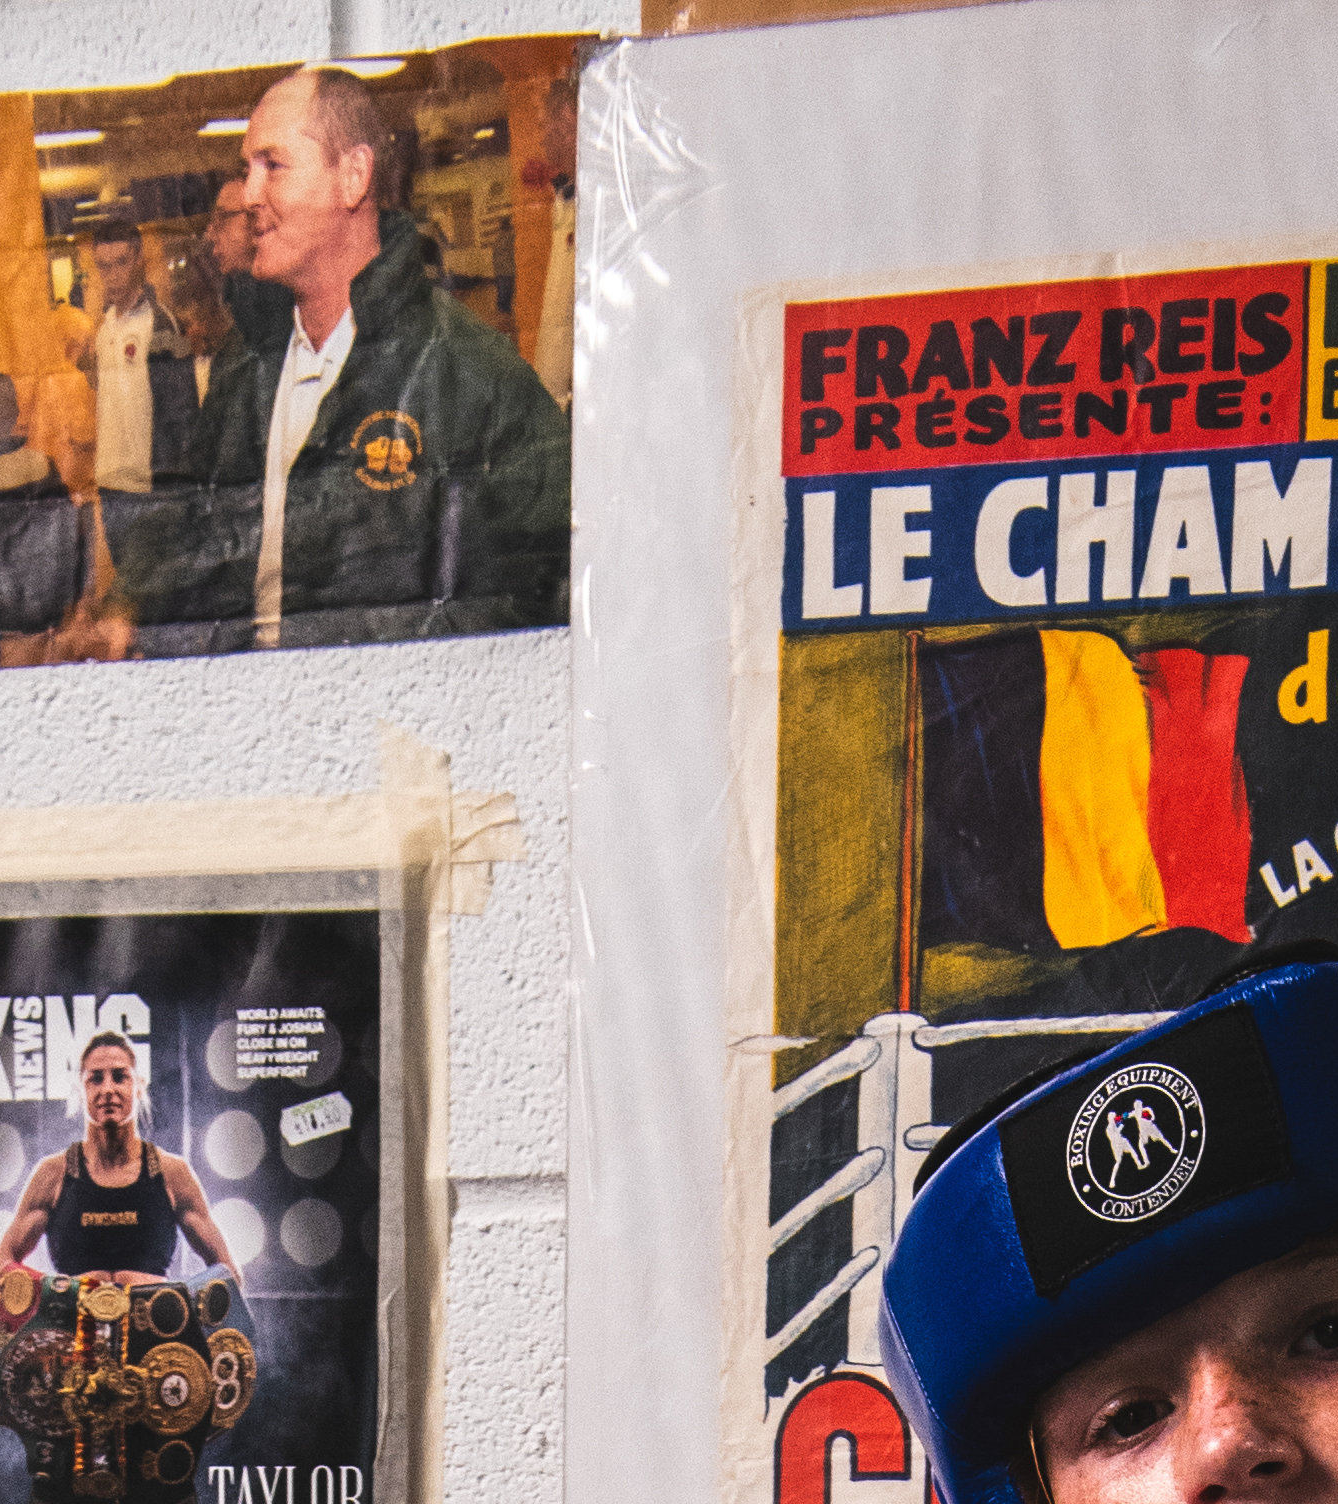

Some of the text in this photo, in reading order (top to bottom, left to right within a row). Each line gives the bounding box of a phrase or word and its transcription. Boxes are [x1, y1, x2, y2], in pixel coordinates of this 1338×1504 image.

[799, 291, 1293, 402] FRANZ REIS
[798, 378, 1274, 456] PRÉSENTE:
[801, 484, 934, 620] LE
[1259, 838, 1334, 909] LA
[12, 996, 43, 1100] NEWS
[1071, 1069, 1199, 1169] BOXING EQUIPMENT
[1101, 1156, 1196, 1217] CONTENDER
